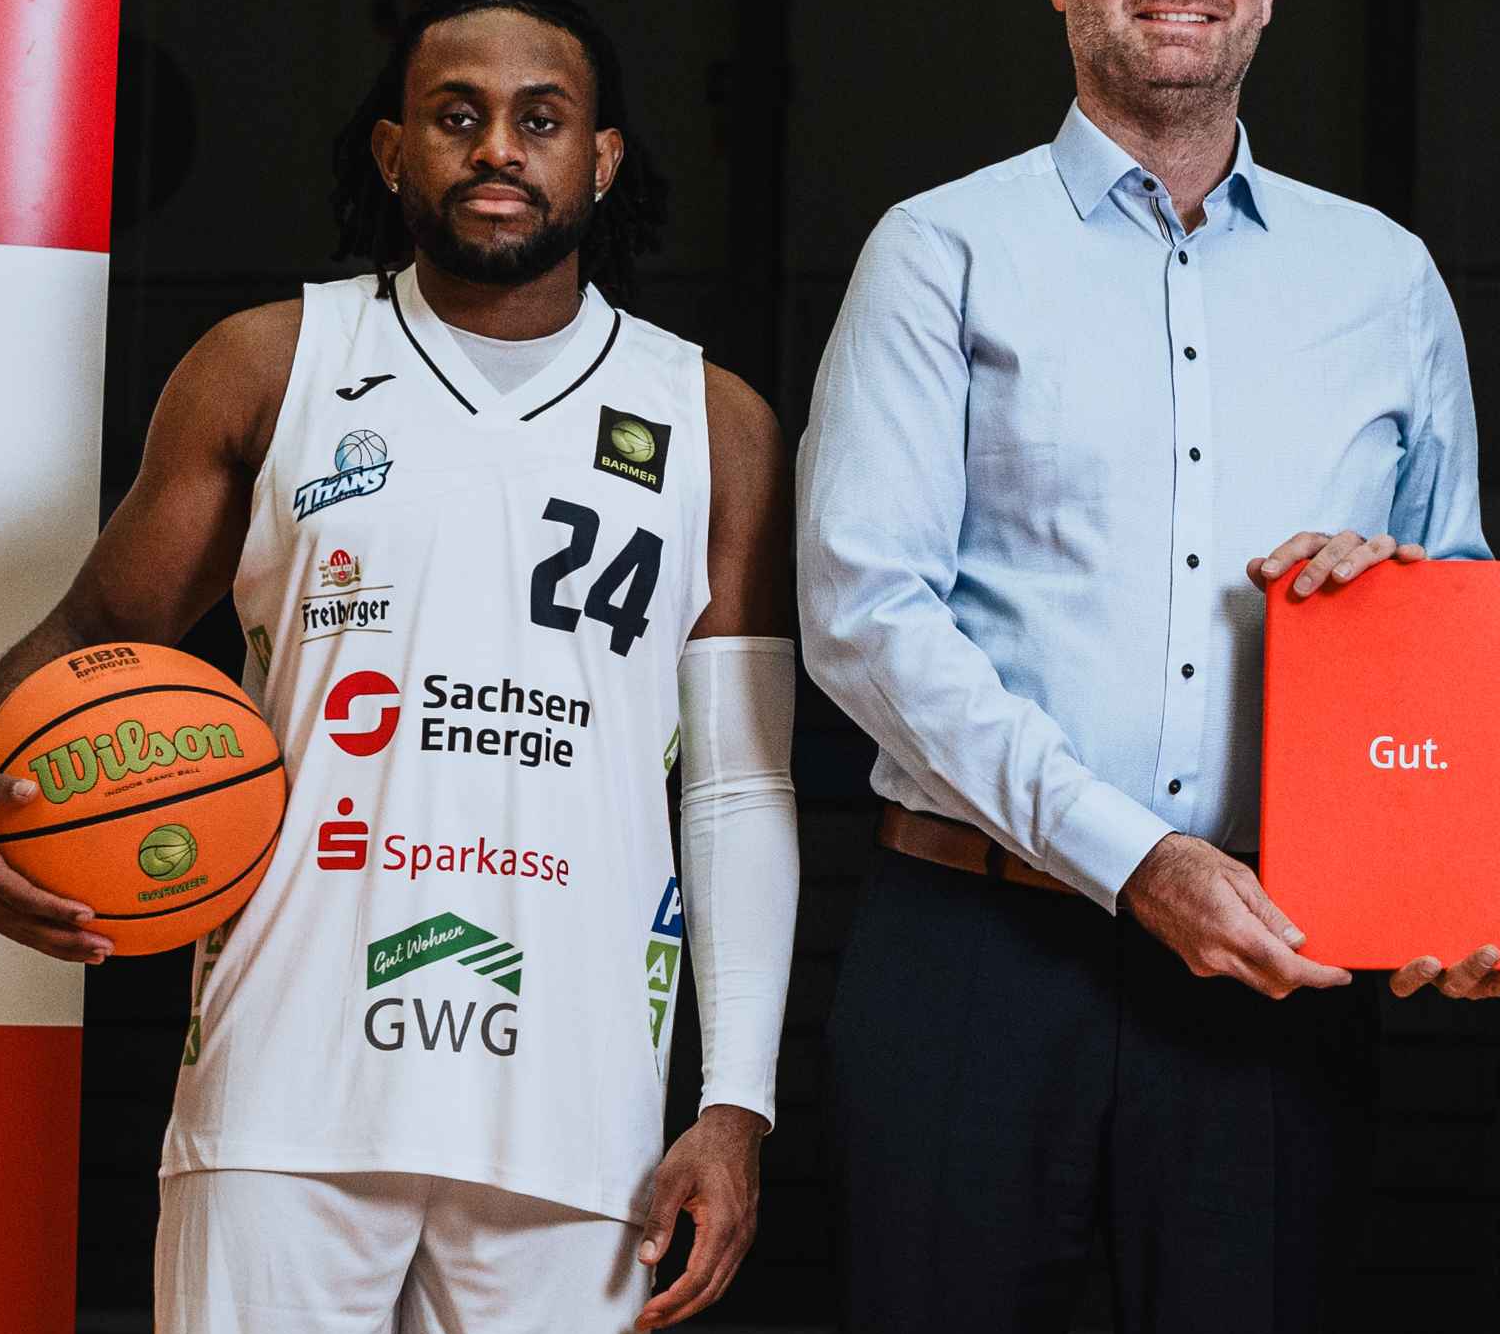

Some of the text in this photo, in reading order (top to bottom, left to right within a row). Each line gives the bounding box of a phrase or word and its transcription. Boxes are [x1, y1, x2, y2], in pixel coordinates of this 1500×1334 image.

[293, 460, 393, 522] TITANS
[601, 455, 657, 485] BARMER
[530, 497, 664, 657] 24
[68, 647, 136, 671] FIBA
[75, 657, 140, 679] APPROVED
[423, 674, 590, 728] Sachsen
[28, 719, 244, 805] Wilson
[420, 717, 574, 768] Energie
[1369, 736, 1449, 770] Gut.
[382, 835, 569, 886] Sparkasse
[138, 875, 209, 902] BARMER
[374, 925, 465, 974] Gut Wohnen
[364, 998, 517, 1056] GWG
